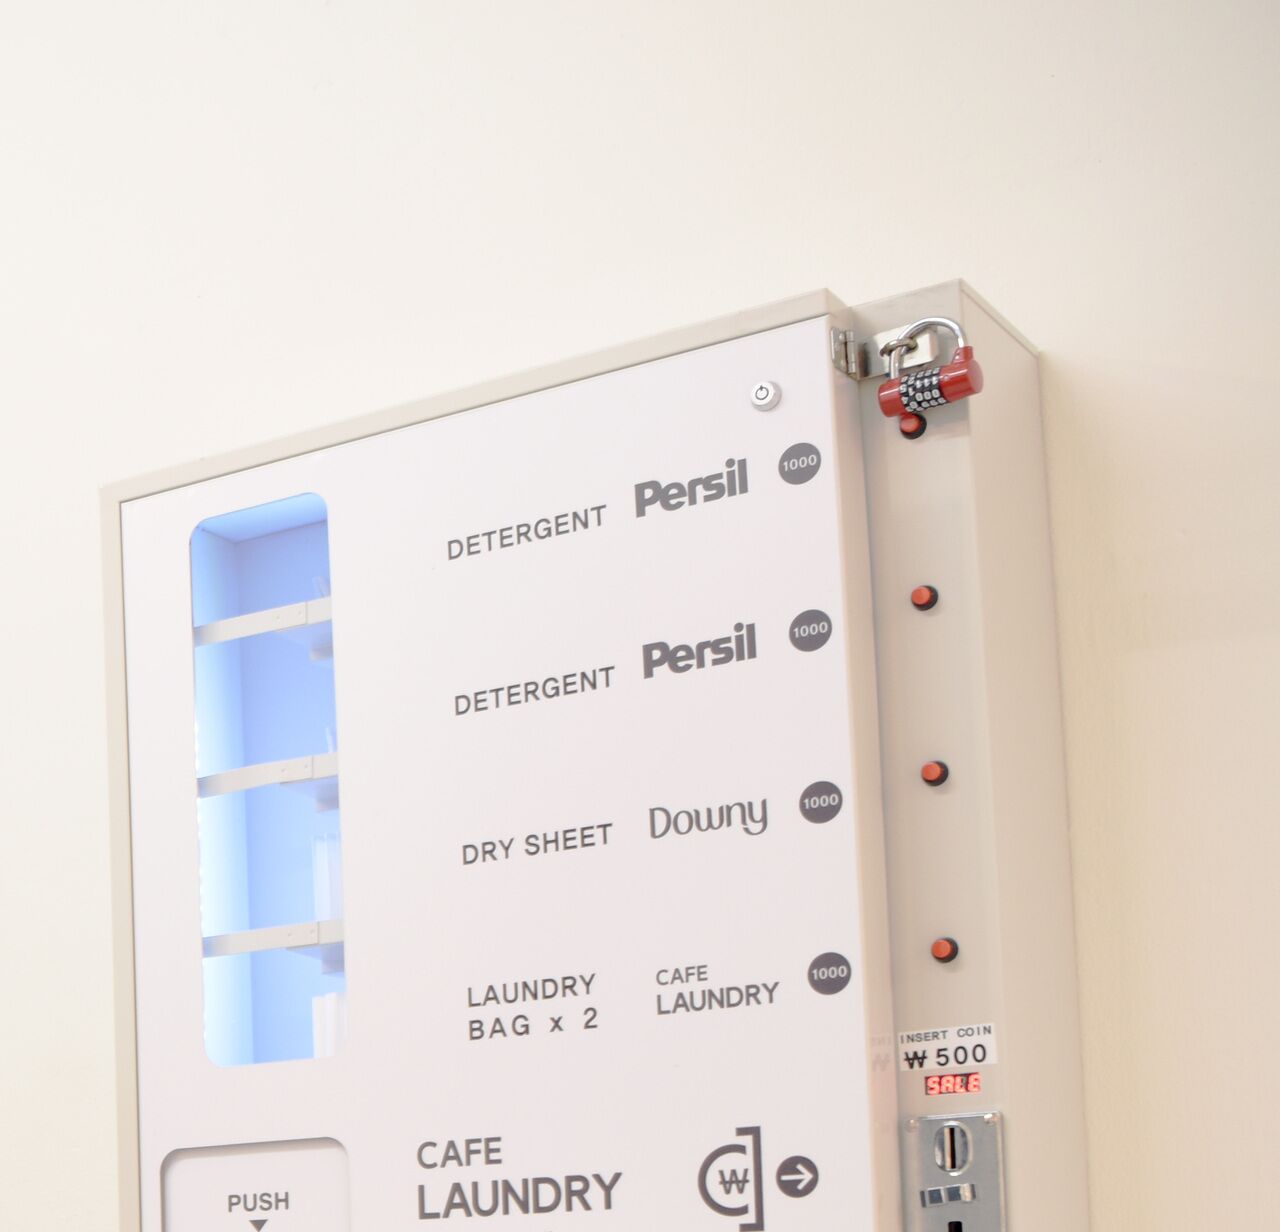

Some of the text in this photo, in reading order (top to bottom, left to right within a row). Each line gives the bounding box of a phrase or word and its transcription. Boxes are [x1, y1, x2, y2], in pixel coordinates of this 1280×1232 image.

[447, 454, 818, 561] DETERGENT Persil 1000
[454, 621, 829, 716] DETERGENT Persil 1000
[462, 793, 840, 866] DRY SHEET Downy 1000
[467, 973, 596, 1008] LAUNDRY
[655, 964, 709, 986] CAFE
[656, 965, 848, 1016] LAUNDRY 1000
[468, 1007, 599, 1041] BAG x 2
[900, 1025, 992, 1044] INSERT COIN
[927, 1073, 981, 1094] SALE
[416, 1136, 503, 1170] CAFE
[227, 1192, 290, 1213] PUSH
[417, 1171, 622, 1220] LAUNDRY
